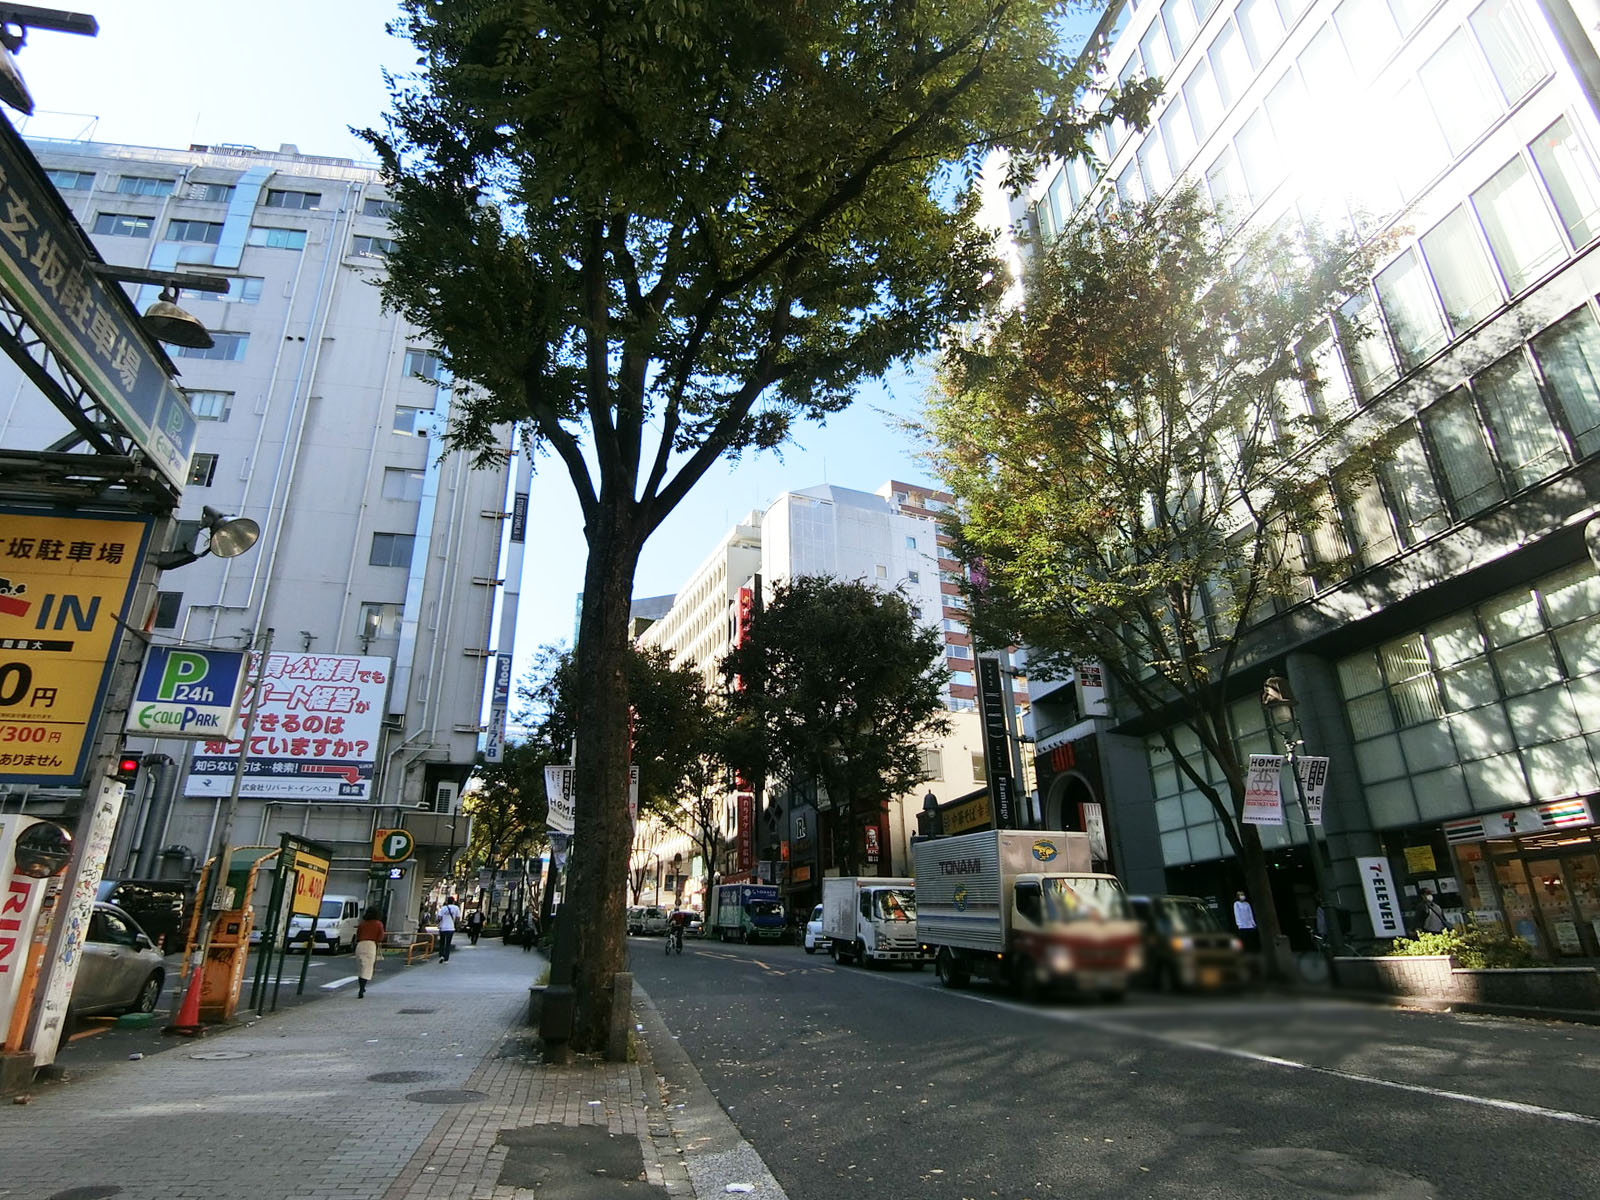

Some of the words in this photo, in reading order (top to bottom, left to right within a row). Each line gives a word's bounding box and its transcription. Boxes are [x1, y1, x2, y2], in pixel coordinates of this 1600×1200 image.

[0, 166, 142, 393] 玄坂駐車場
[0, 537, 125, 564] 坂駐車場
[35, 594, 102, 631] IN
[157, 651, 209, 701] P
[176, 686, 214, 702] 24h
[240, 713, 346, 735] できるのは
[998, 776, 1009, 820] Flamingo
[389, 836, 407, 857] P
[939, 858, 981, 876] TONAMI
